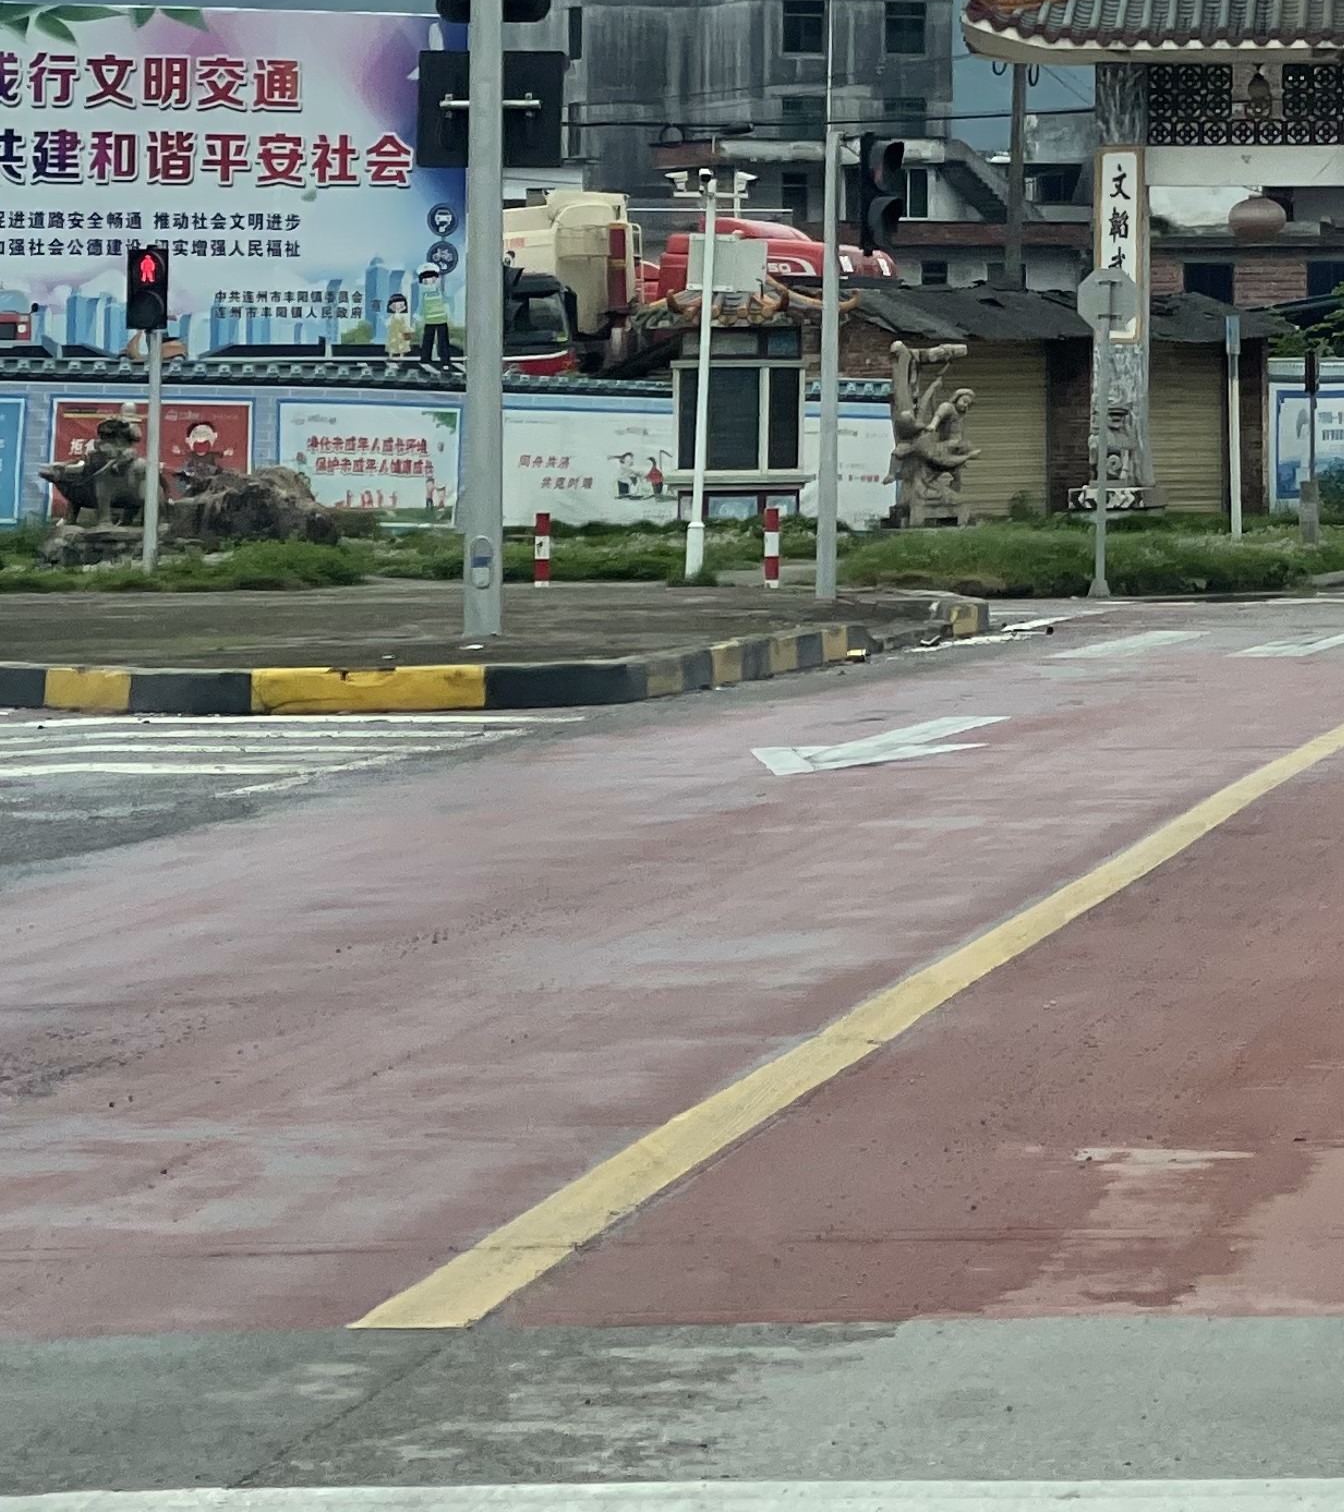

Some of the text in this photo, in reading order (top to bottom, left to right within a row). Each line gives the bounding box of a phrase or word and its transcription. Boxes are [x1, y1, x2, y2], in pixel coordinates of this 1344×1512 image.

[0, 211, 301, 231] 进道路安全畅通 推动社会文明进步
[0, 238, 141, 257] 强社会公德建设
